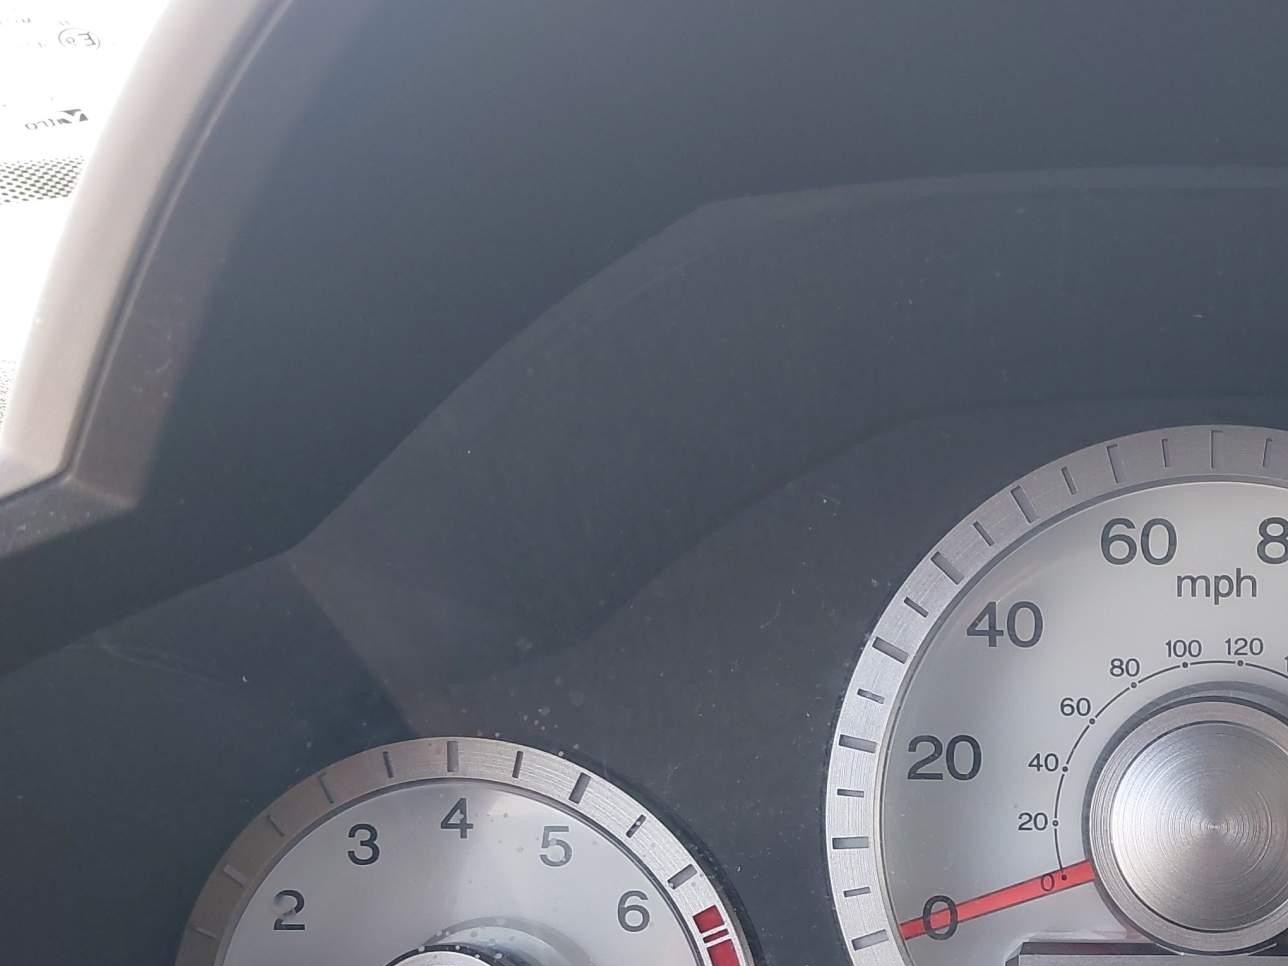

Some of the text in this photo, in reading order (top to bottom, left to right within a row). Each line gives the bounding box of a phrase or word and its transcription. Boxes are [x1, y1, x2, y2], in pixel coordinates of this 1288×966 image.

[1101, 518, 1177, 565] 60
[1176, 569, 1258, 605] mph
[966, 601, 1044, 648] 40
[1165, 640, 1202, 658] 100
[1225, 638, 1264, 656] 120
[1110, 659, 1140, 677] 80
[1060, 698, 1091, 716] 60
[907, 735, 982, 781] 20
[1028, 753, 1059, 772] 40
[440, 798, 474, 839] 4
[1018, 813, 1048, 831] 20
[347, 823, 380, 865] 3
[540, 826, 573, 867] 5
[1040, 874, 1055, 892] 0
[273, 890, 305, 930] 2
[617, 891, 651, 932] 6
[923, 895, 959, 940] 0
